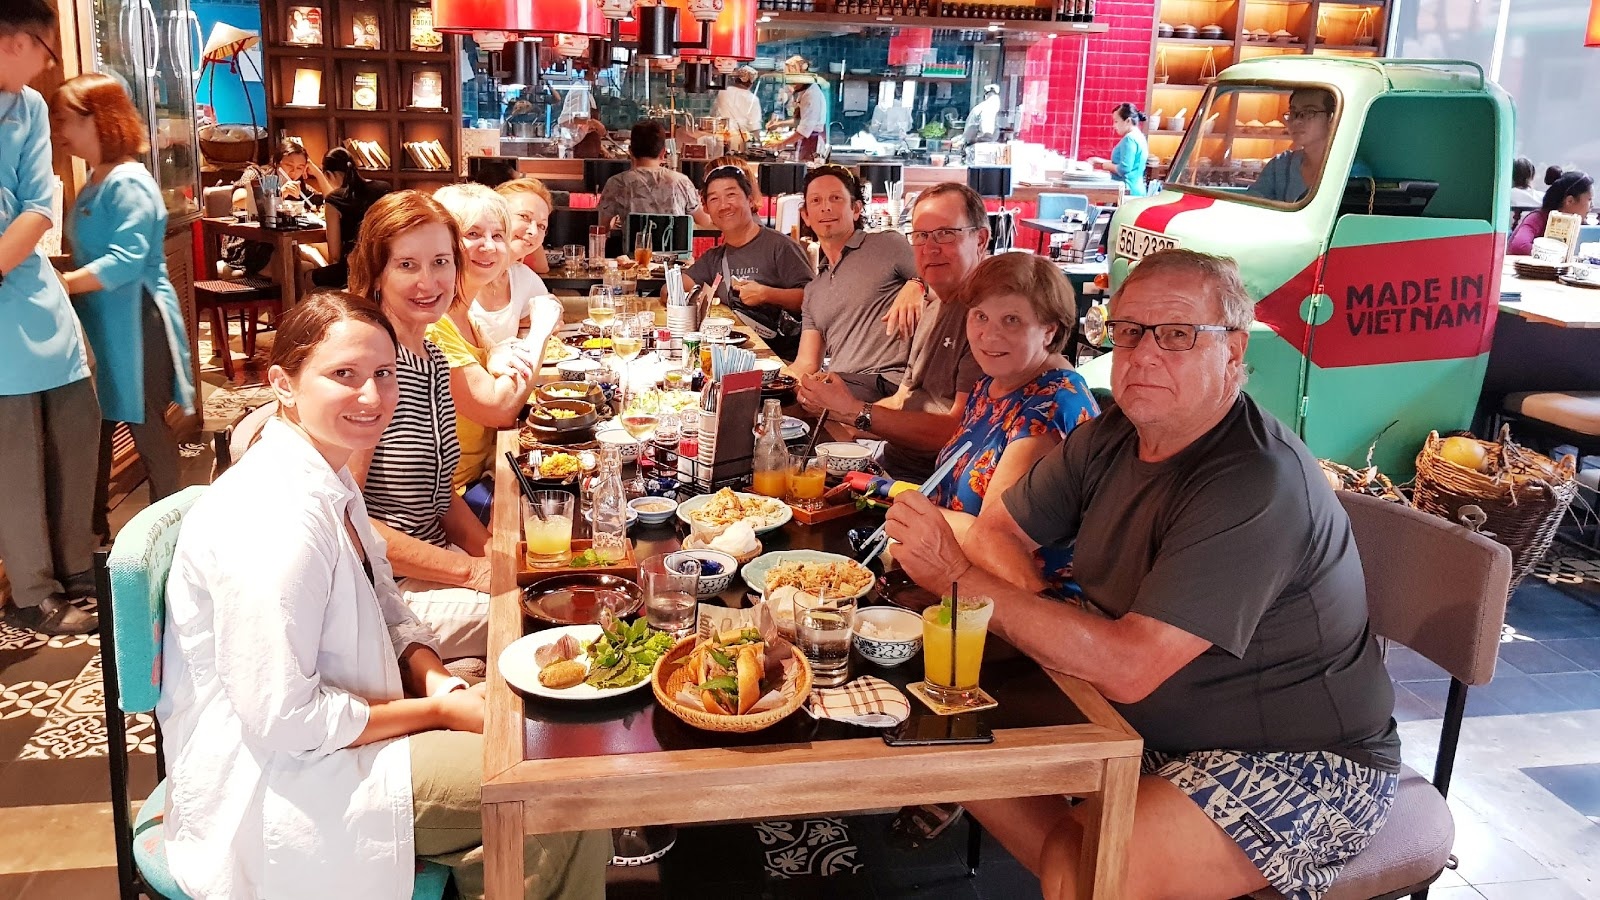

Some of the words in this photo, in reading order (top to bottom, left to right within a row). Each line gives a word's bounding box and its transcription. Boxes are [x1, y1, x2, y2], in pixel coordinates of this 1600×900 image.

[1346, 278, 1440, 310] MADE
[1451, 274, 1483, 301] IN
[1346, 302, 1482, 336] VIETNAM
